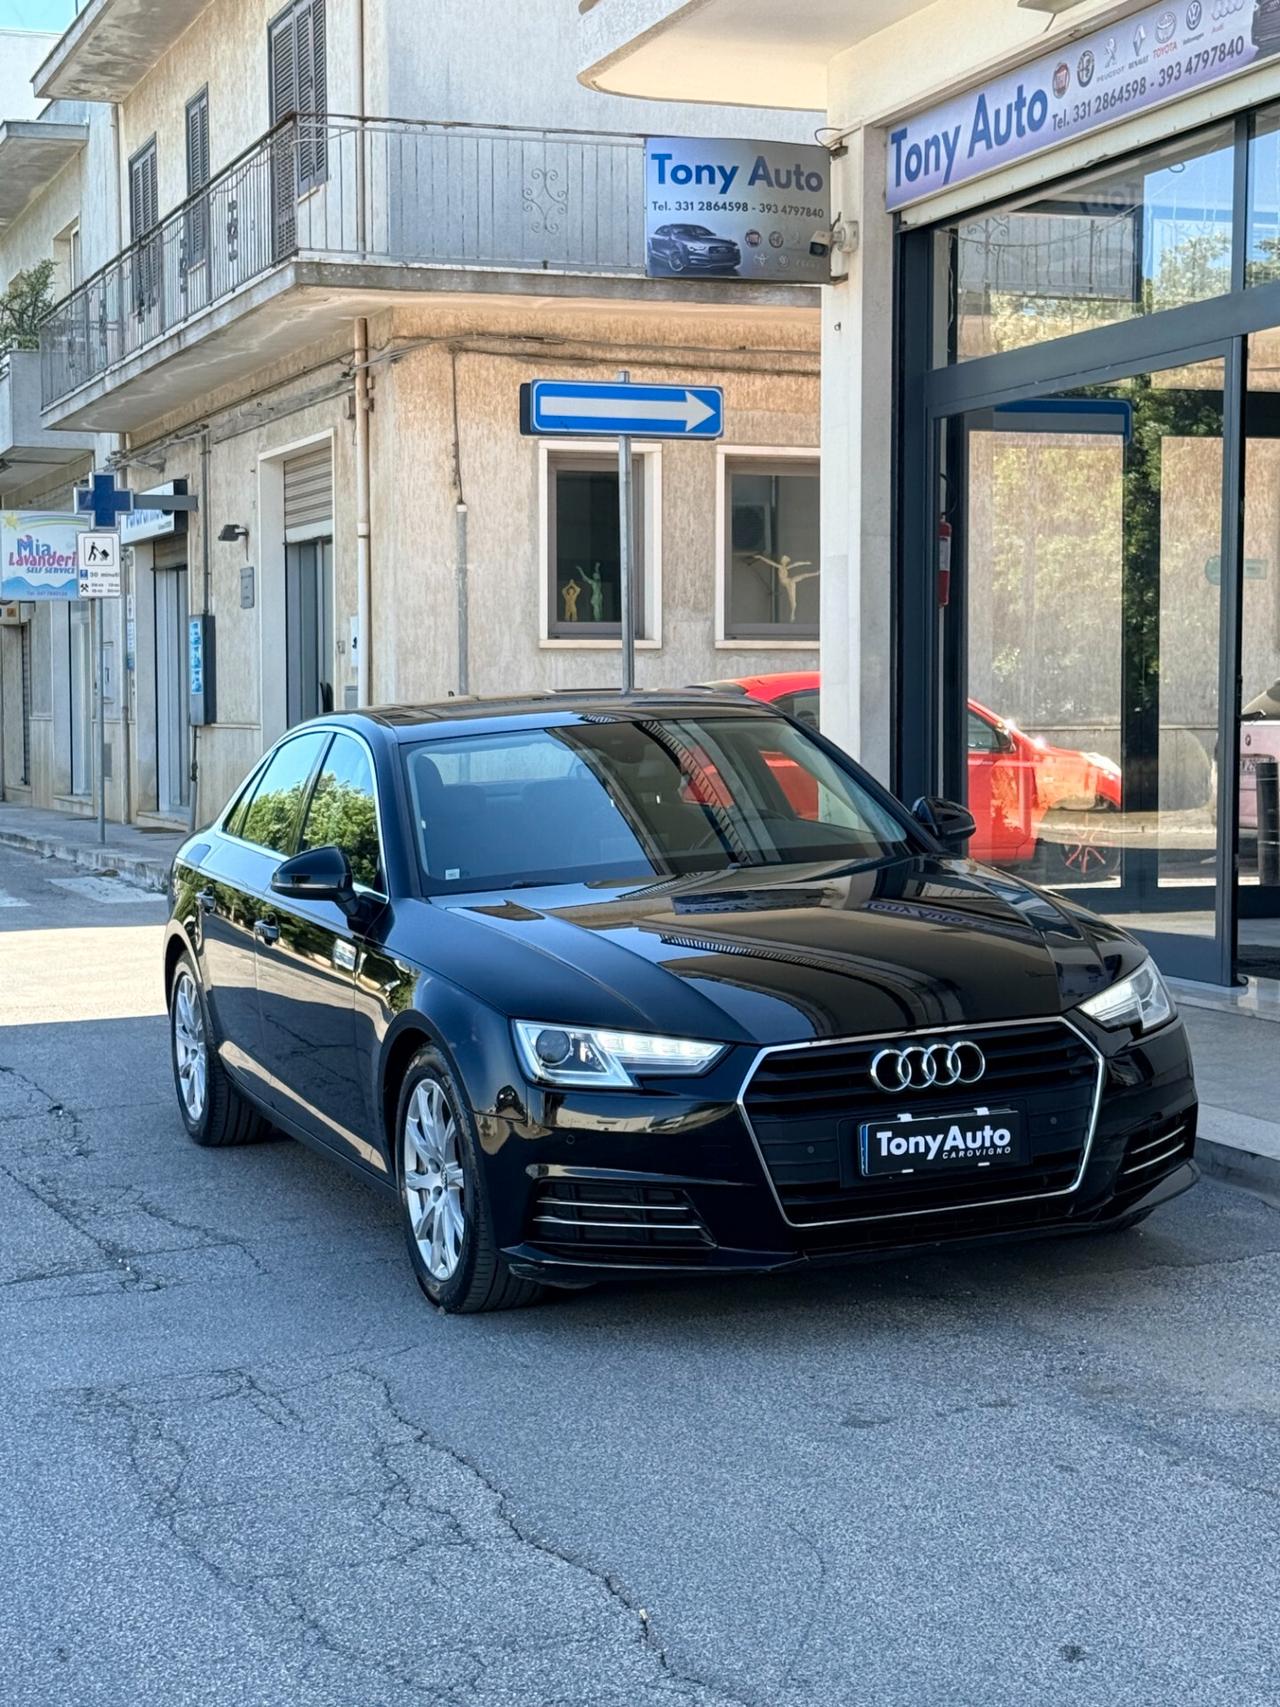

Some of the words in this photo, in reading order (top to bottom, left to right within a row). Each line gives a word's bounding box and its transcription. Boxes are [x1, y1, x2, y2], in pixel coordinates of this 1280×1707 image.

[1152, 41, 1178, 59] TOYOTA
[1052, 111, 1070, 131] Tel.
[1073, 102, 1091, 122] 331
[1094, 76, 1147, 115] 2864598
[1158, 62, 1182, 87] 393
[1184, 35, 1245, 76] 4797840
[891, 125, 962, 188] Tony
[967, 84, 1049, 159] Auto
[651, 153, 740, 195] Tony
[747, 155, 824, 193] Auto
[652, 201, 672, 212] Tel.
[675, 202, 694, 212] 331
[698, 201, 749, 213] 2864598
[759, 203, 779, 214] 393
[781, 205, 824, 219] 4797840
[16, 534, 51, 557] Mia
[8, 551, 77, 567] Lavanderi
[942, 1146, 1011, 1159] CAROVIGNO
